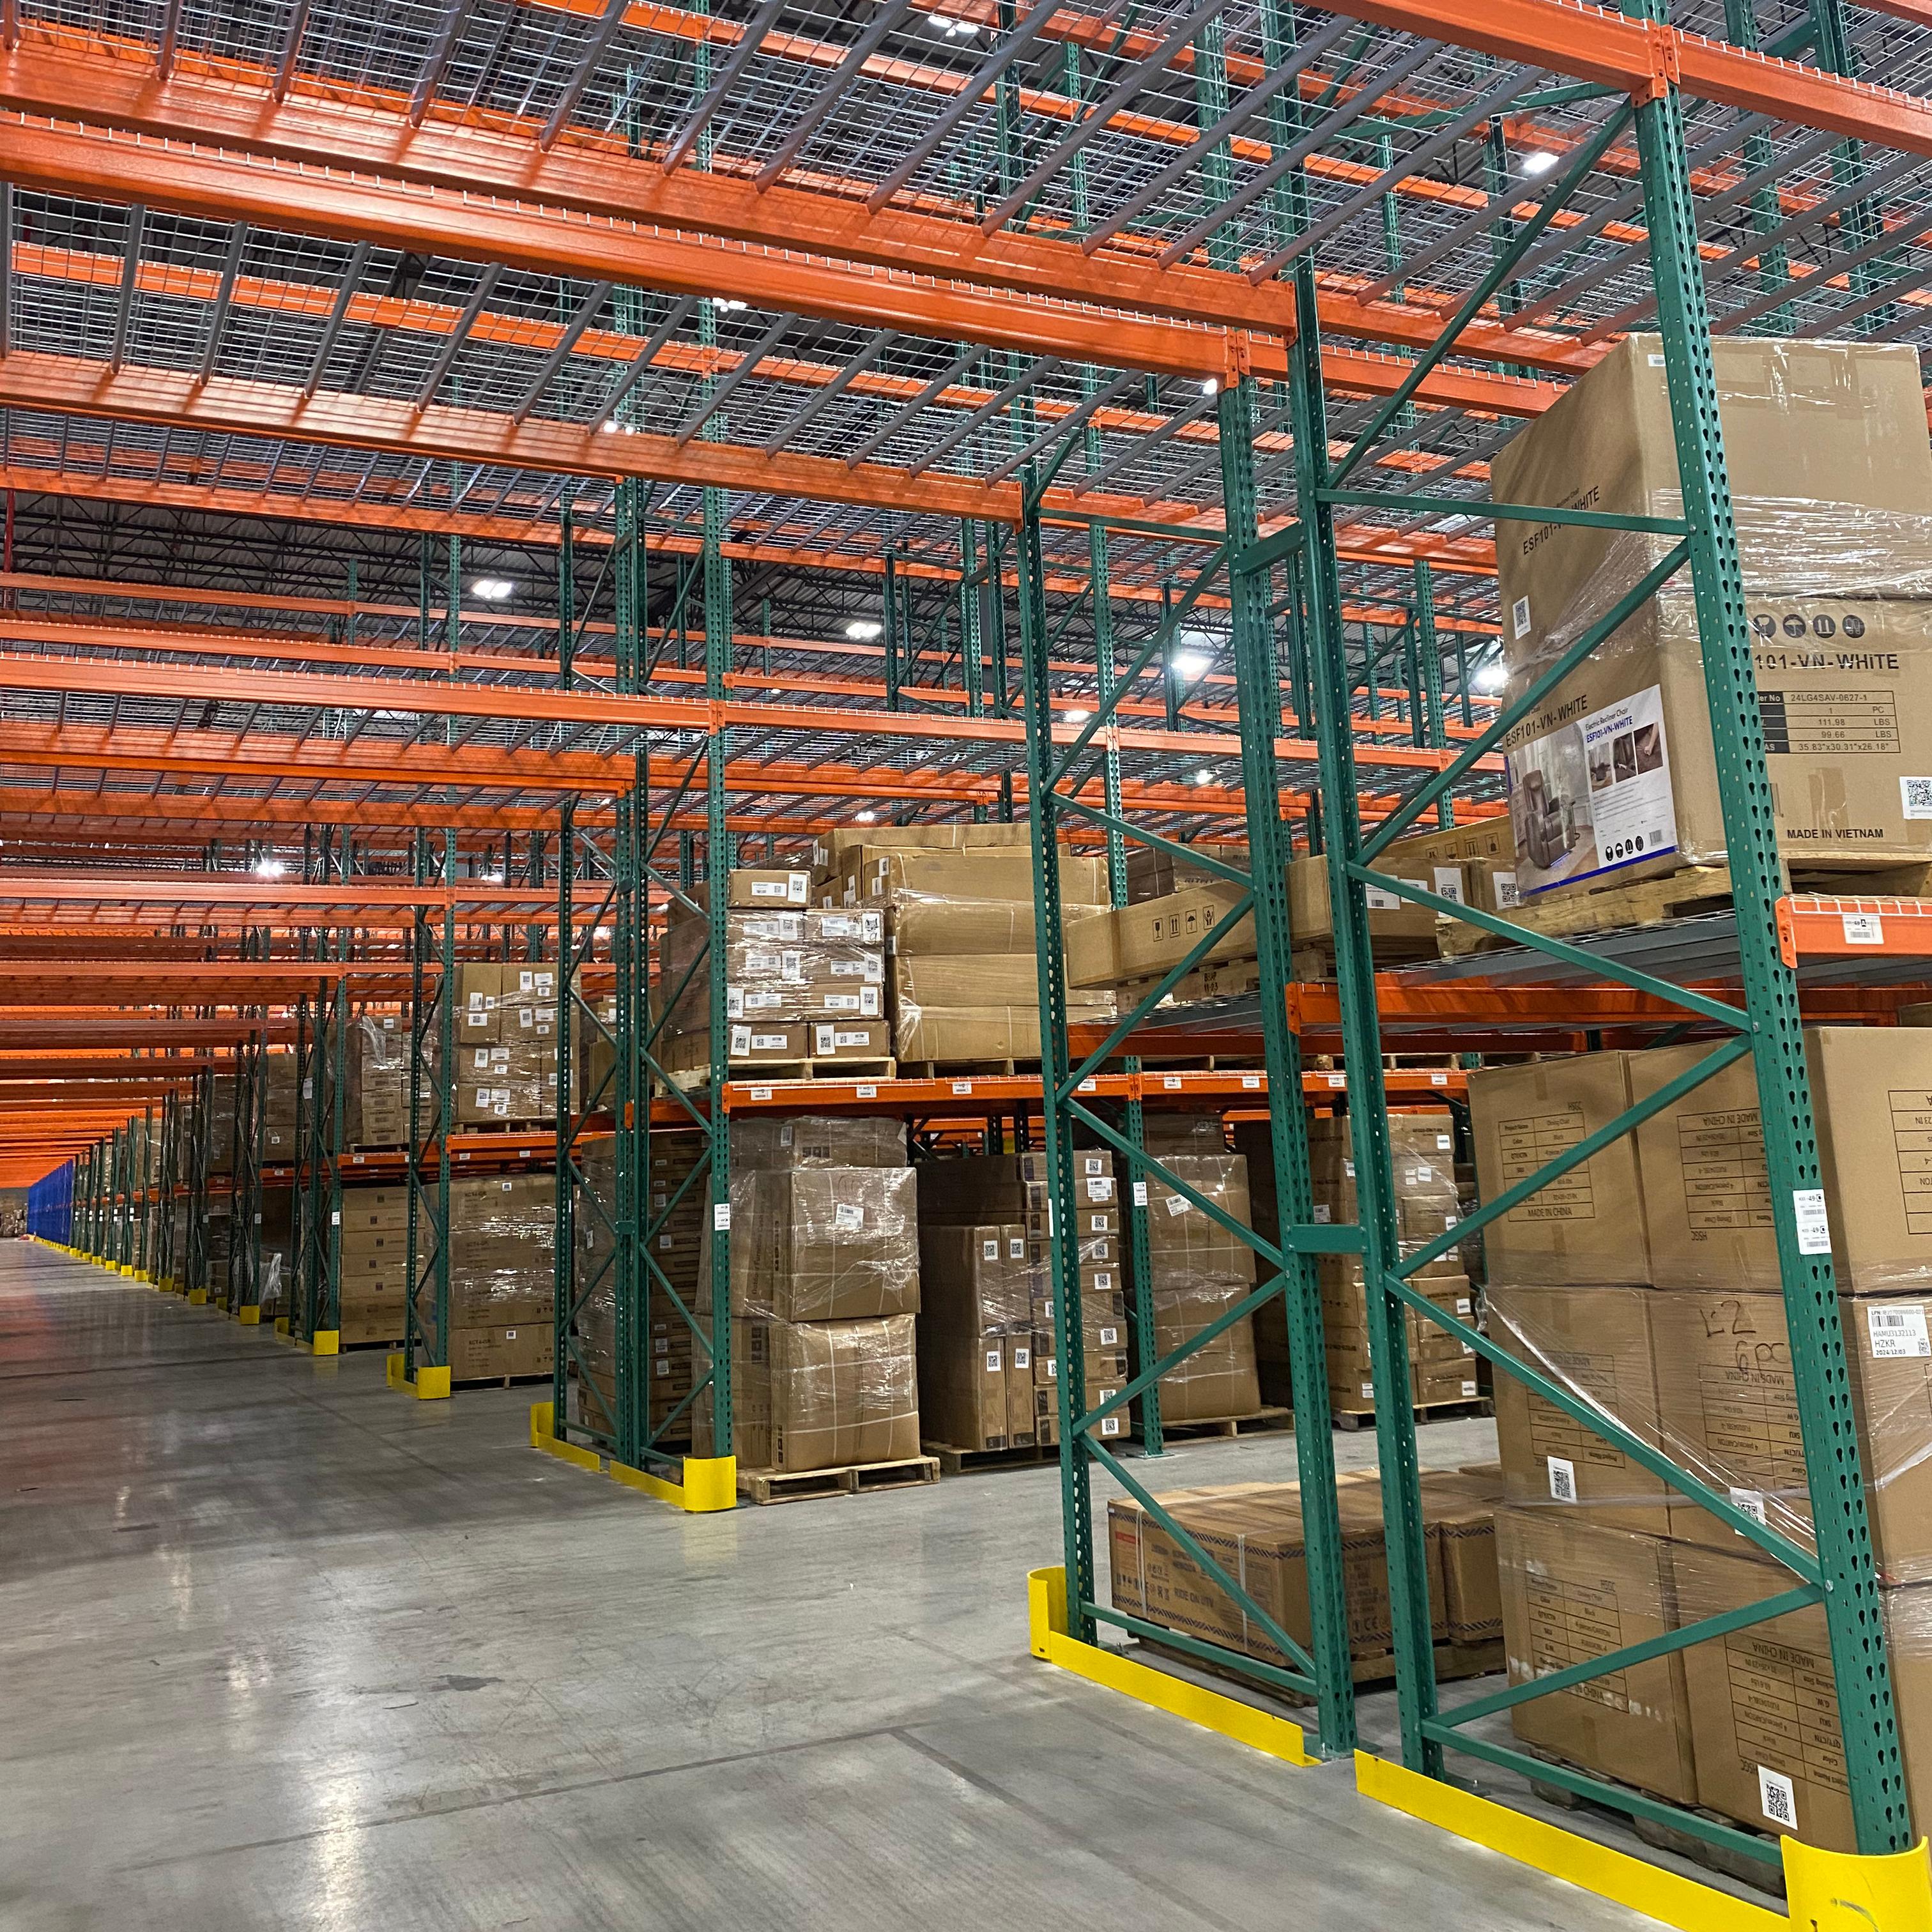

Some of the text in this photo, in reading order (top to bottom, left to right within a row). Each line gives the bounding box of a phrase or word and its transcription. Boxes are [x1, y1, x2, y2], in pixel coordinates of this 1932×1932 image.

[1523, 486, 1600, 555] ESF101-WHITE
[1754, 654, 1899, 670] 101-VN-WHITE
[1585, 720, 1600, 732] Electric
[1616, 707, 1629, 717] Chair
[1586, 716, 1633, 743] ESF101-VN-WHITE
[1787, 829, 1883, 838] MADE IN VIETNAM
[1703, 1112, 1758, 1126] MADE IN CHINA
[1528, 1207, 1572, 1217] MADE IN CHINA
[1875, 1339, 1896, 1347] HZKR
[1725, 1370, 1749, 1382] CHINA
[1789, 1431, 1800, 1439] SKU
[1784, 1448, 1805, 1458] TY/CTN
[1752, 1642, 1814, 1669] MADE IN CHINA
[1816, 1698, 1830, 1708] G.W.
[1820, 1717, 1831, 1728] SKU
[1823, 1756, 1837, 1767] Color
